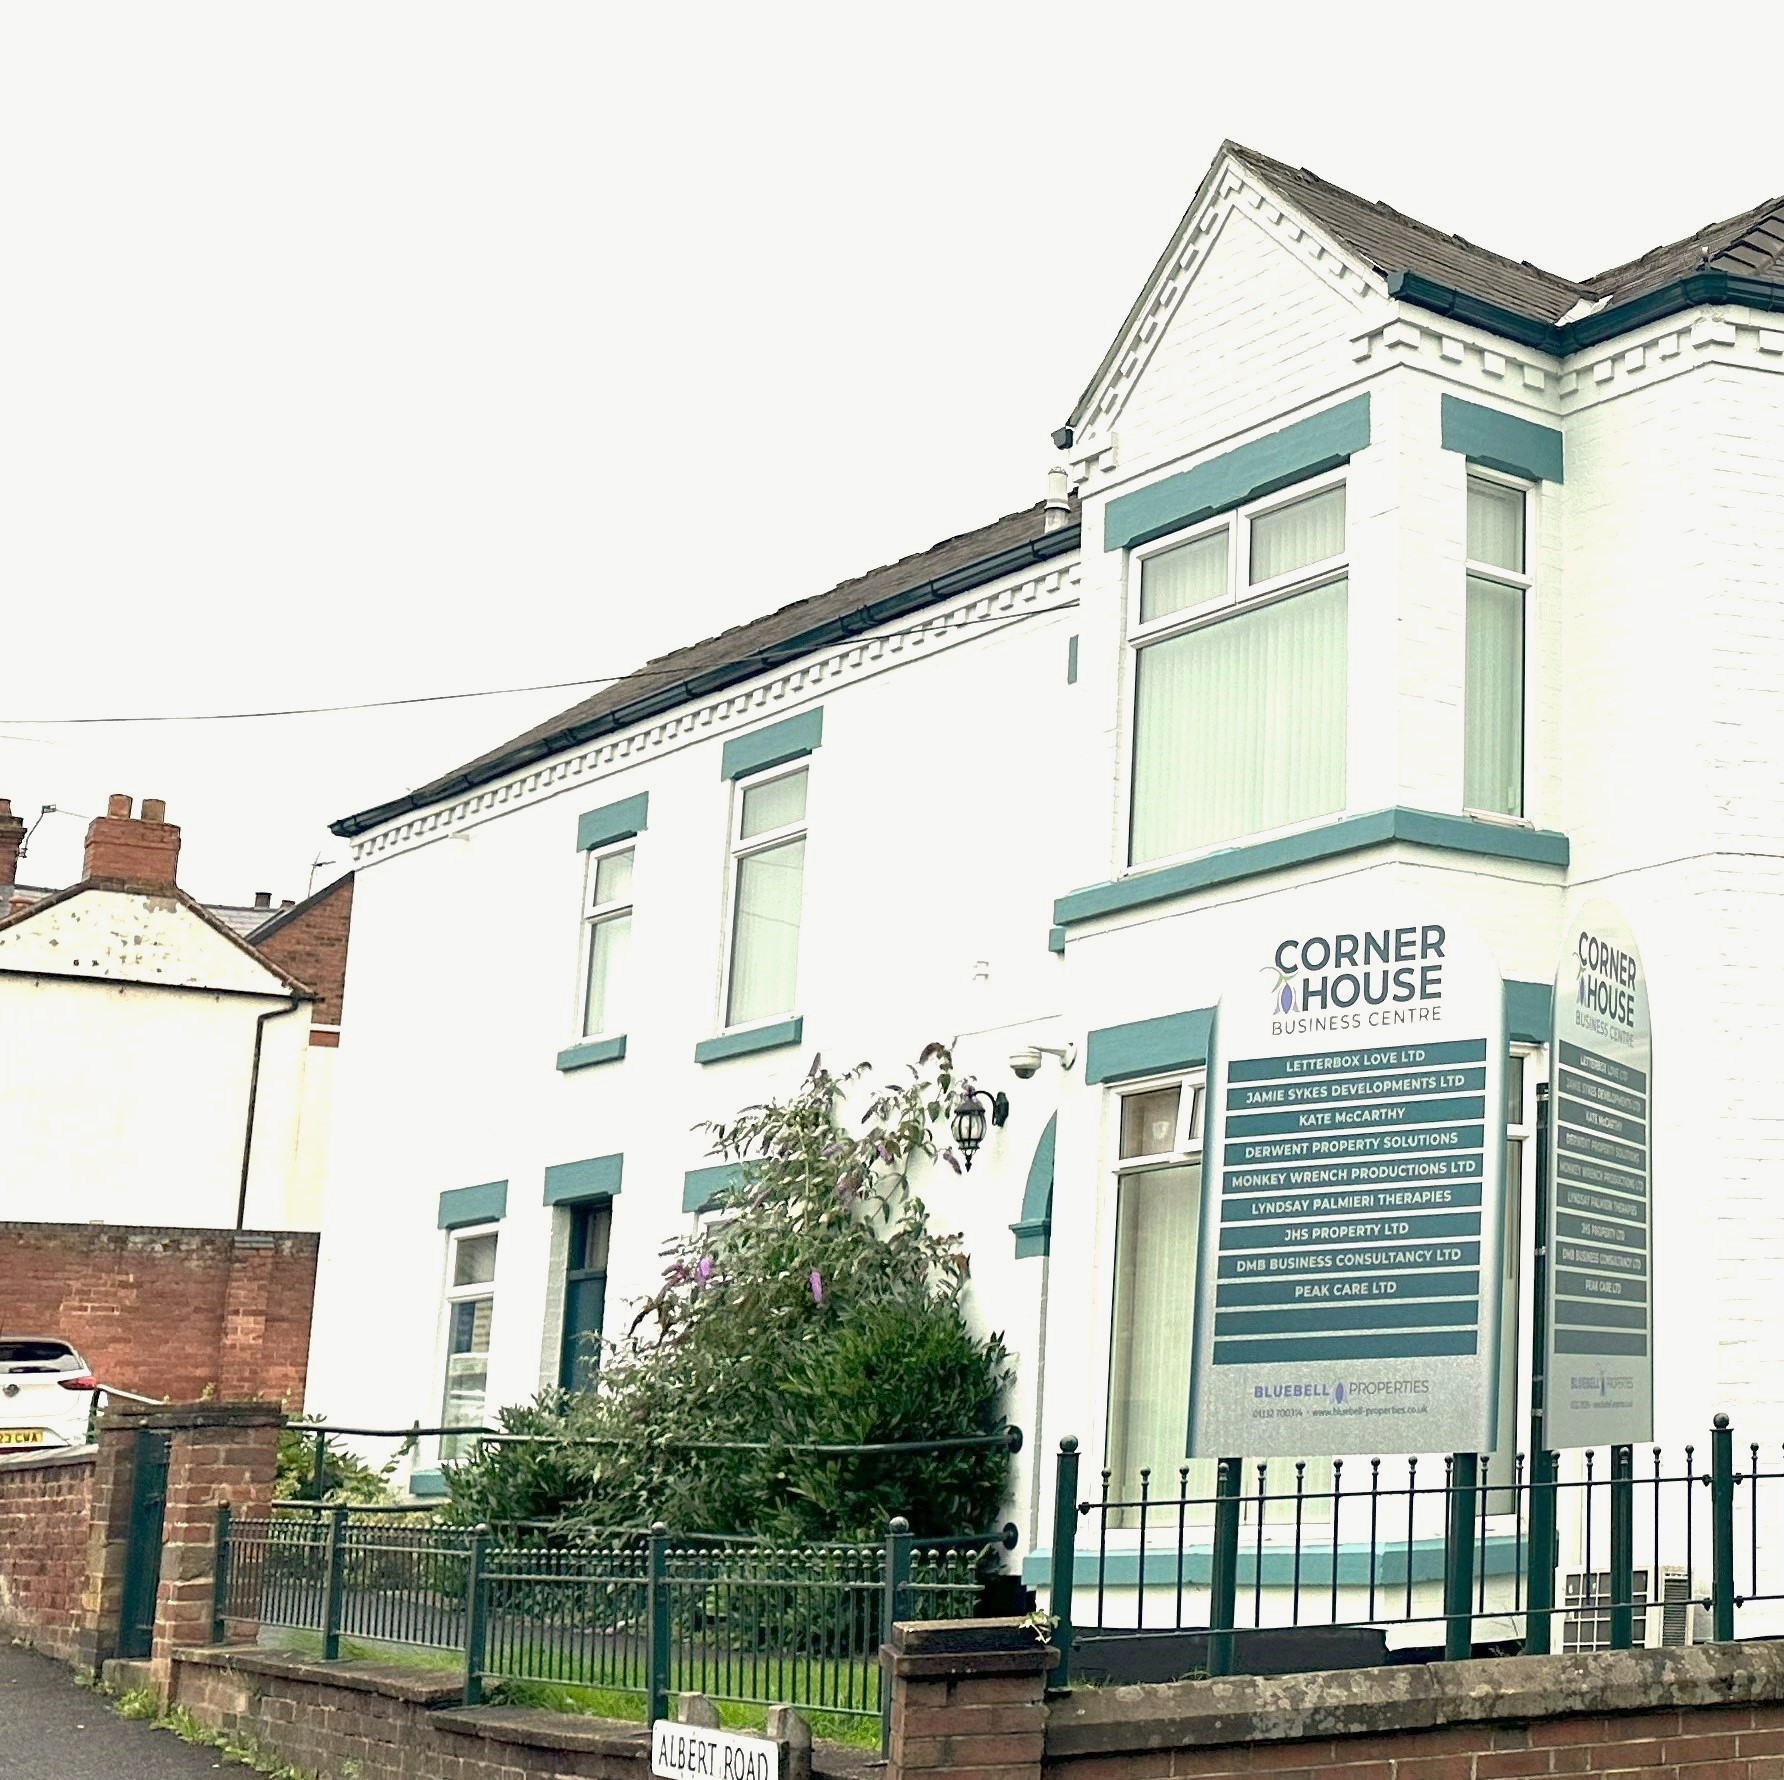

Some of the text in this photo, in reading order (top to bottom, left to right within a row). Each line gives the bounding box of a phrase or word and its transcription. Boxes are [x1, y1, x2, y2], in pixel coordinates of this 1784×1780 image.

[1275, 925, 1446, 974] CORNER
[1579, 932, 1636, 992] CORNER
[1302, 965, 1442, 1011] HOUSE
[1588, 974, 1634, 1028] HOUSE
[1272, 1006, 1442, 1035] BUSINESS CENTRE
[1576, 1010, 1608, 1038] BUSINESS
[1286, 1050, 1426, 1072] LETTERBOX LOVE LTD
[1246, 1075, 1465, 1104] JAMIE SYKES DEVELOPMENTS LTD
[1299, 1108, 1406, 1126] KATE McCARTHY
[1246, 1132, 1458, 1158] DERWENT PROPERTY SOLUTIONS
[1232, 1160, 1476, 1188] MONKEY WRENCH PRODUCTIONS LTD
[1252, 1190, 1451, 1215] LYNDSAY PALMIERI THERAPIES
[1284, 1222, 1408, 1242] JHS PROPERTY LTD
[1236, 1248, 1461, 1272] DMB BUSINESS CONSULTANCY LTD
[1295, 1282, 1397, 1298] PEAK CARE LTD
[1254, 1380, 1430, 1398] BLUEBELL PROPERTIES
[658, 1734, 768, 1780] ALBERT ROAD
